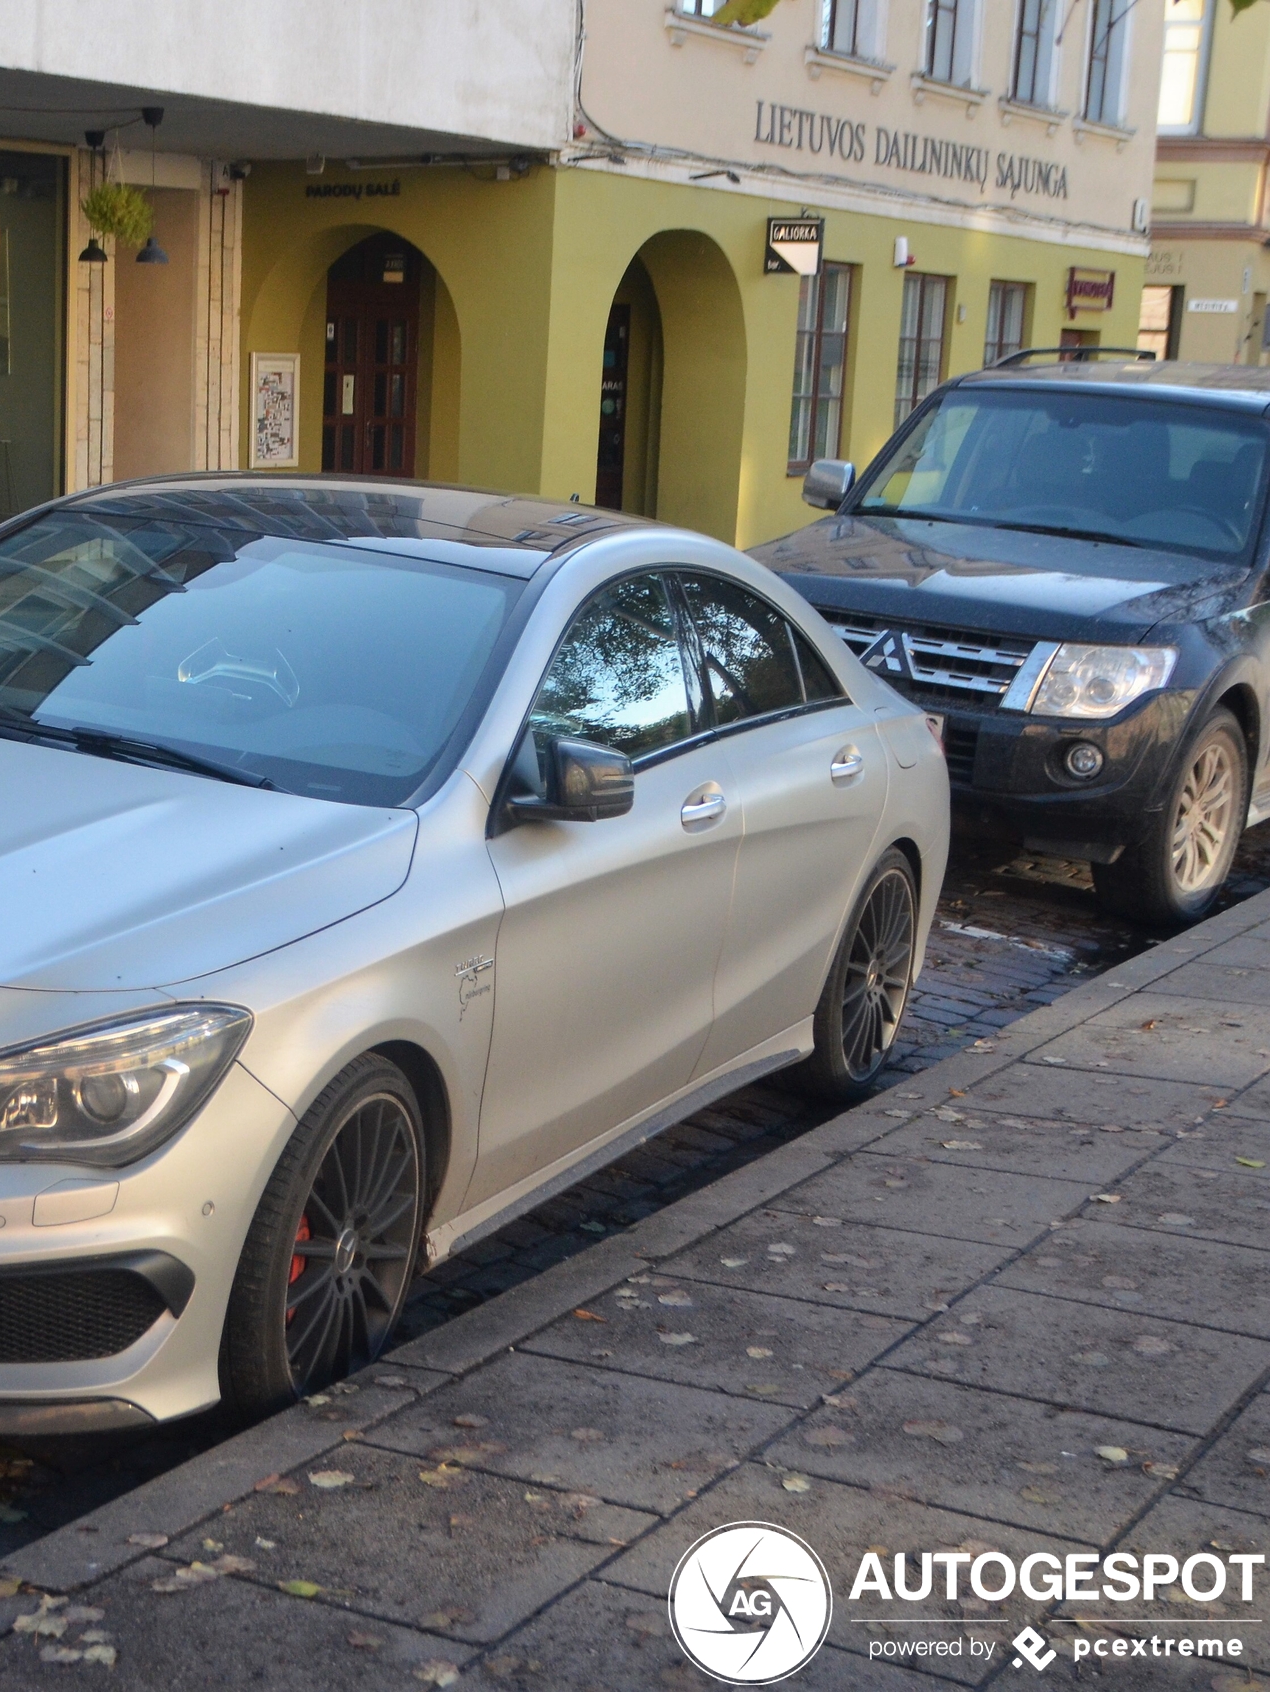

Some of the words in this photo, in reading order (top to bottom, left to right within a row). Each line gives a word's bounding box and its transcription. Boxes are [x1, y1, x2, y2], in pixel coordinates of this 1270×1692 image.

[754, 99, 866, 163] LIETUVOS
[874, 126, 990, 194] DAILININKŲ
[995, 151, 1069, 200] SĄJUNGA
[773, 225, 818, 241] GALIORKA
